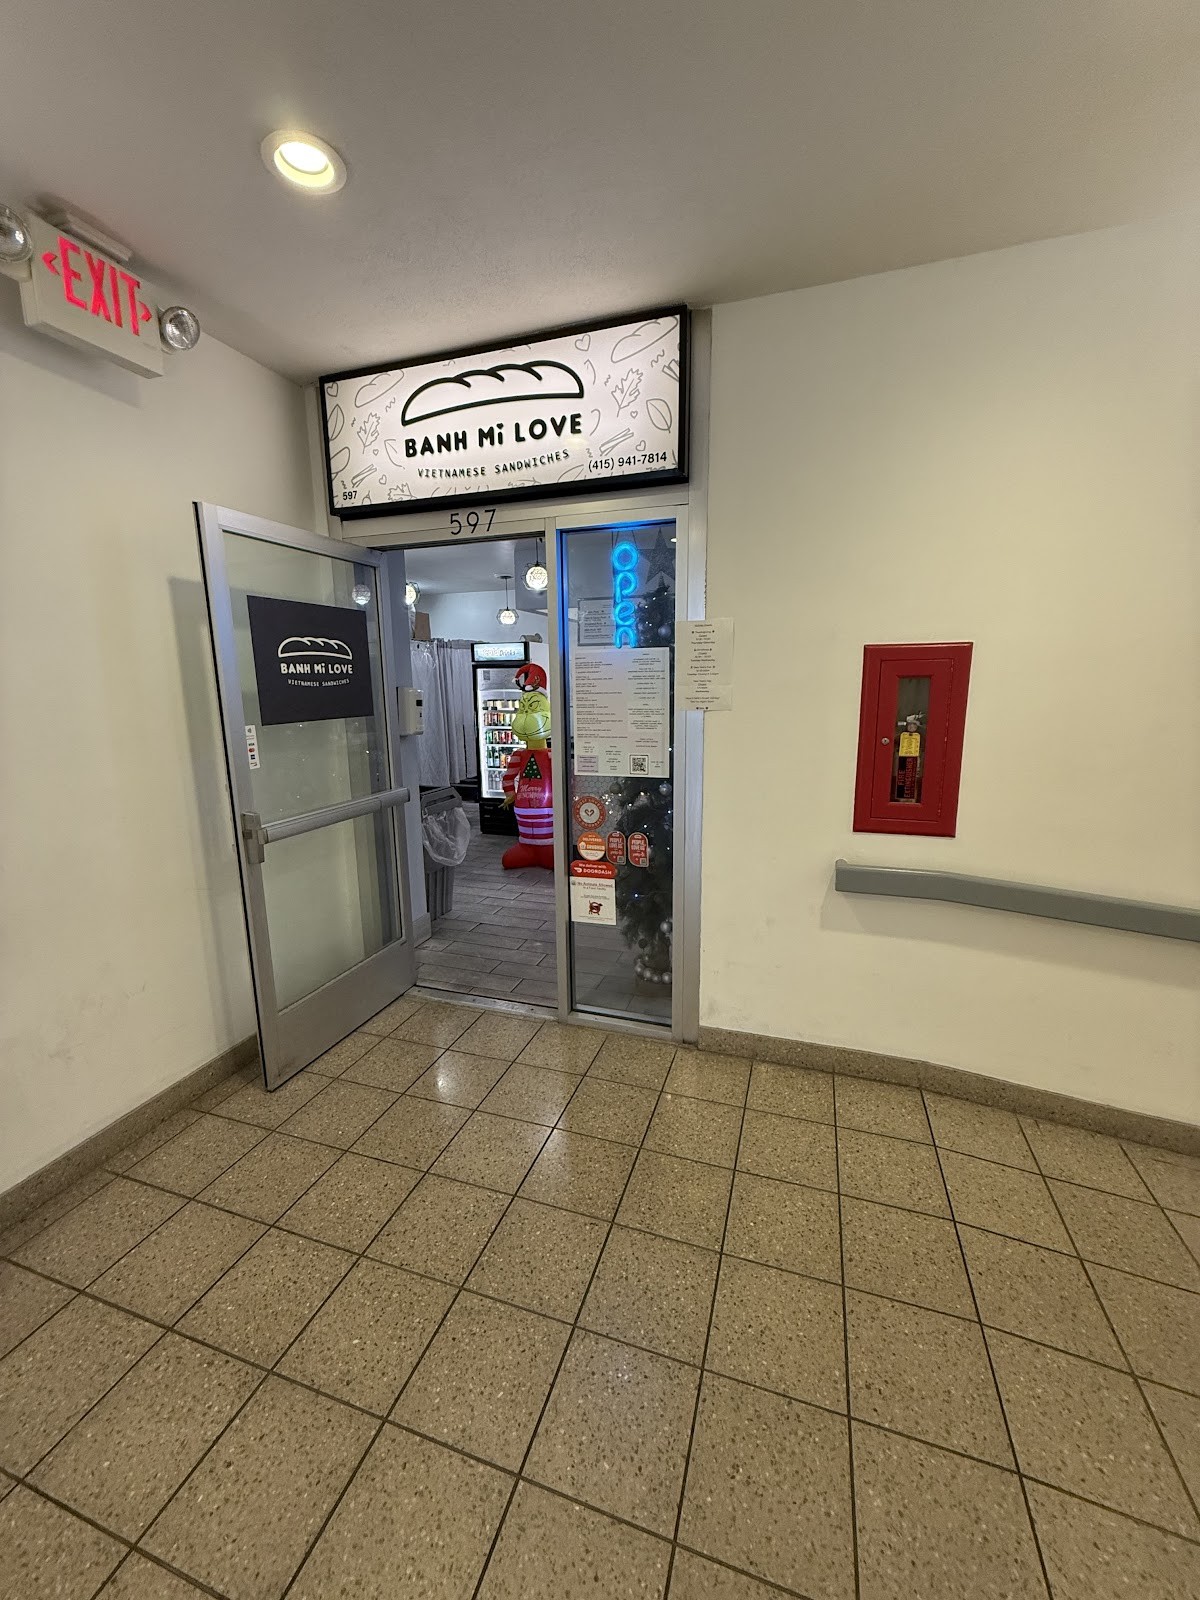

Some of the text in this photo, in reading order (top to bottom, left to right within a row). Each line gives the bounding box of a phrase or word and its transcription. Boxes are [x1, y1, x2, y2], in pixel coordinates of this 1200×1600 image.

[58, 235, 141, 336] EXIT
[404, 430, 468, 458] BANH
[514, 413, 582, 443] LOVE
[417, 449, 570, 479] VIETNAMESE SANDWICHES
[588, 451, 667, 473] (415) 941-7814
[342, 490, 358, 501] 597
[450, 508, 497, 536] 597
[280, 662, 311, 674] BANH
[328, 663, 353, 674] LOVE
[287, 678, 350, 687] VIETNAMESE SANDWICHES
